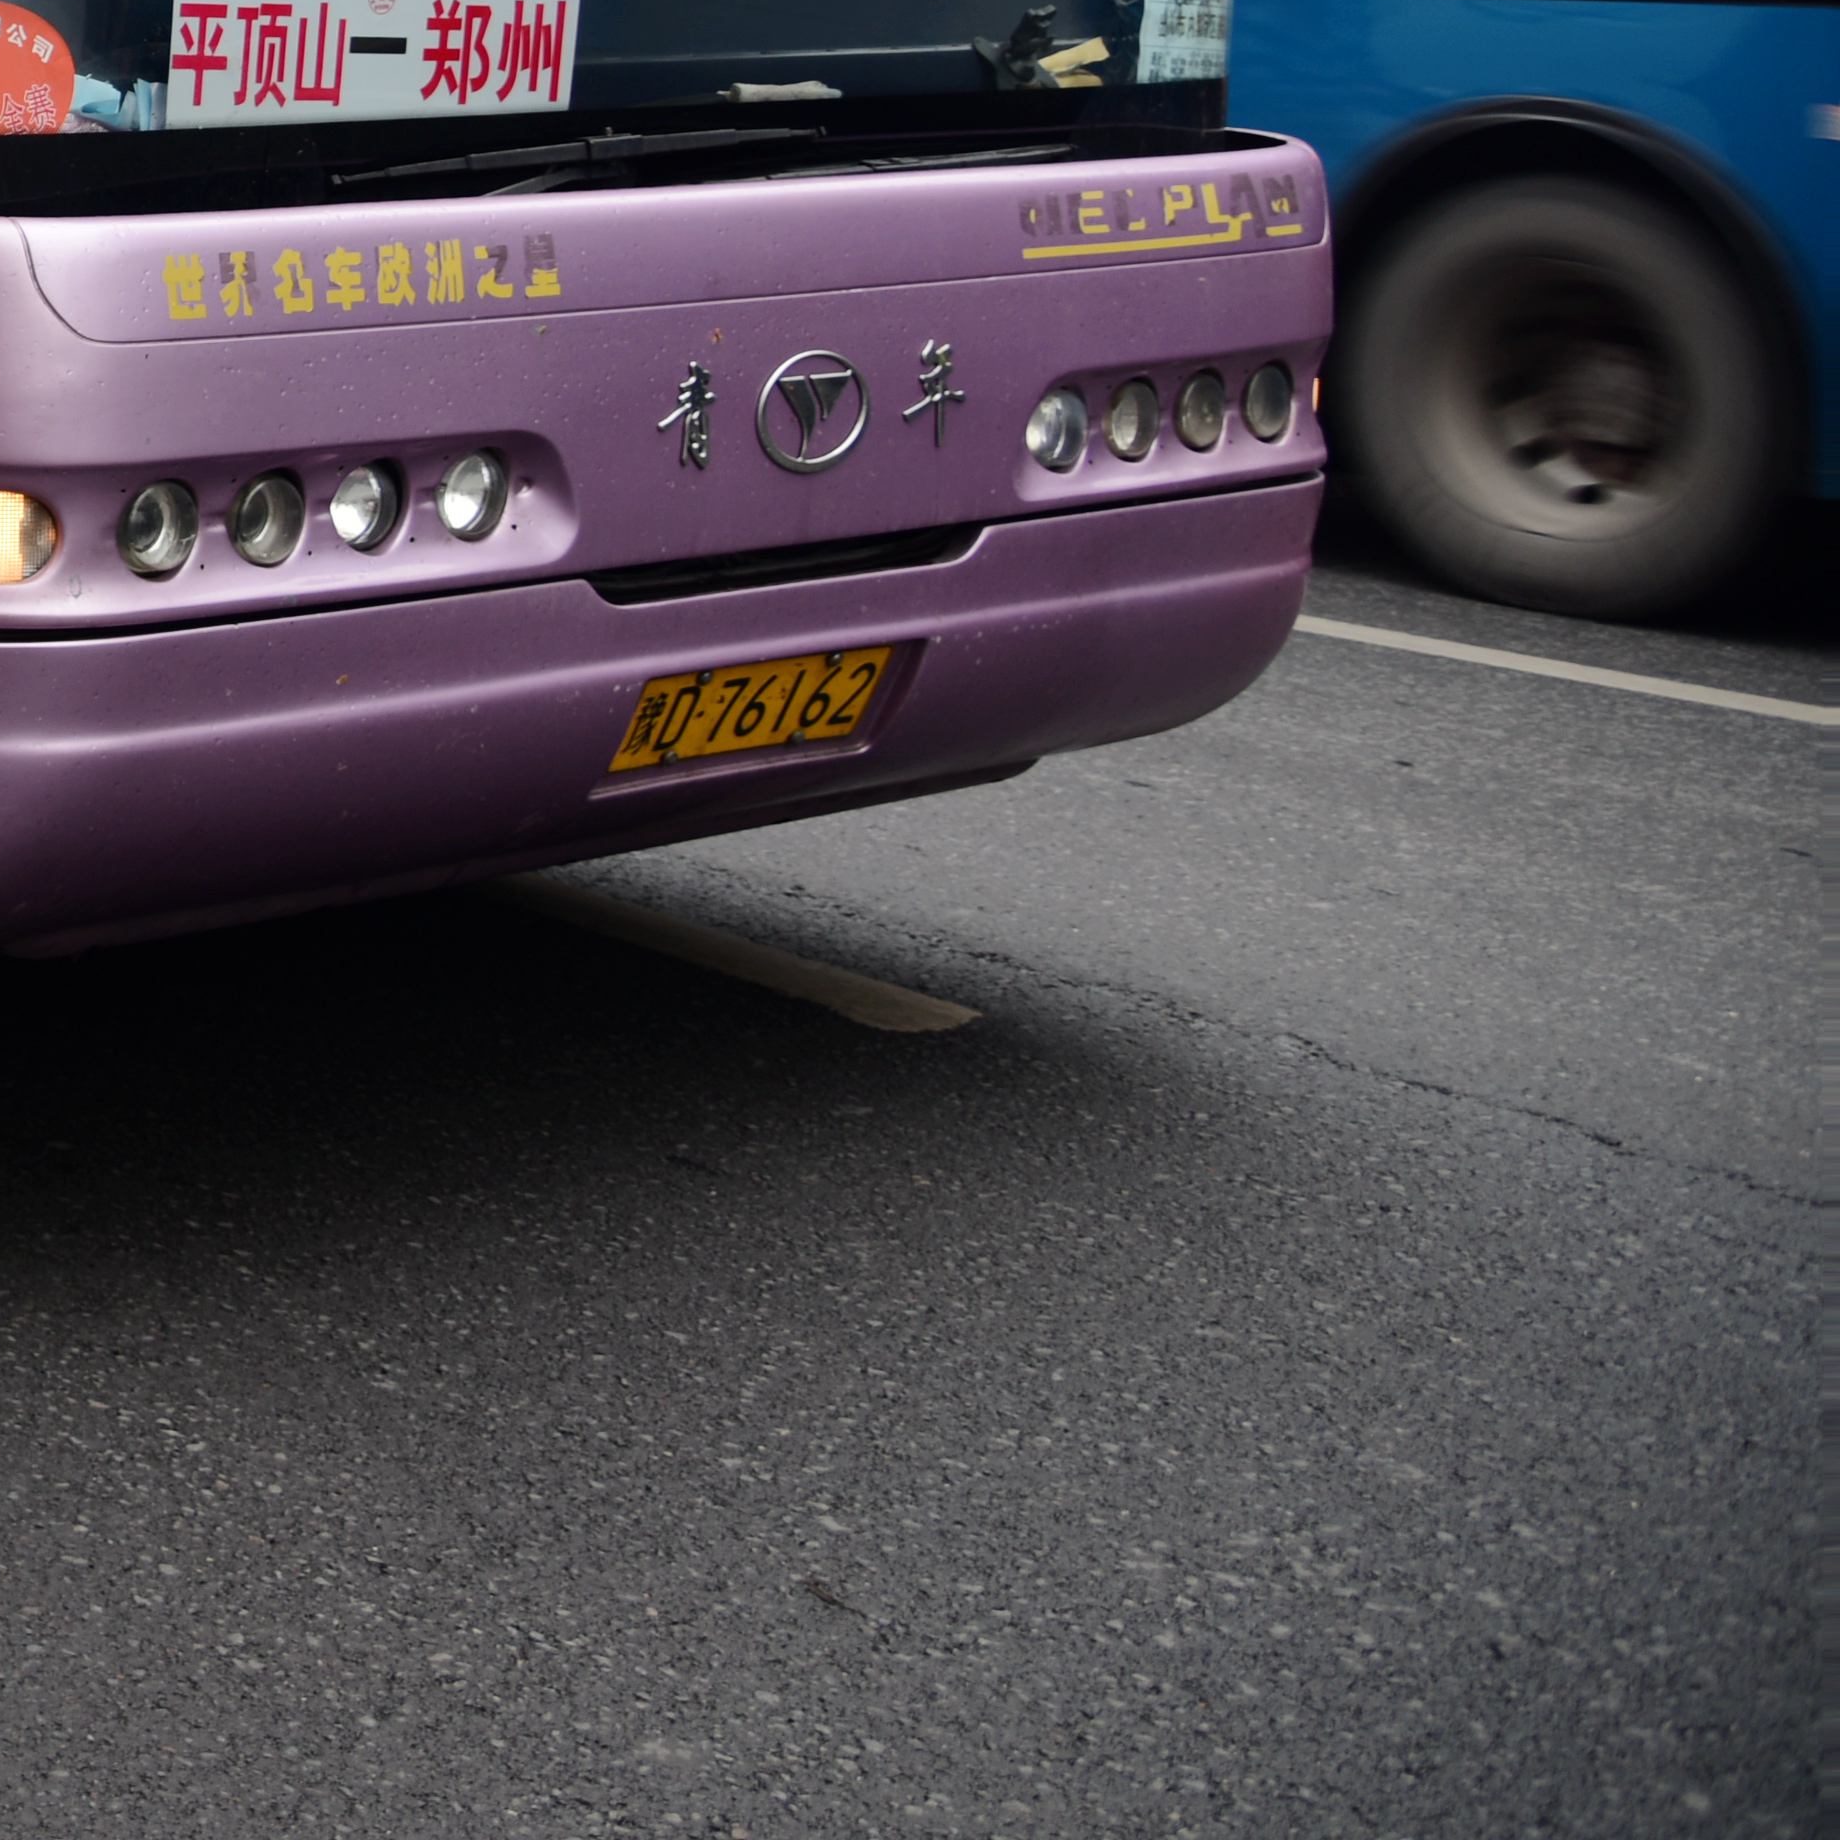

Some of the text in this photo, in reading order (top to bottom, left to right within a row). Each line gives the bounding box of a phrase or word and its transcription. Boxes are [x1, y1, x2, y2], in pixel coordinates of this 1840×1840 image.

[161, 232, 561, 321] 世界名车欧洲之星
